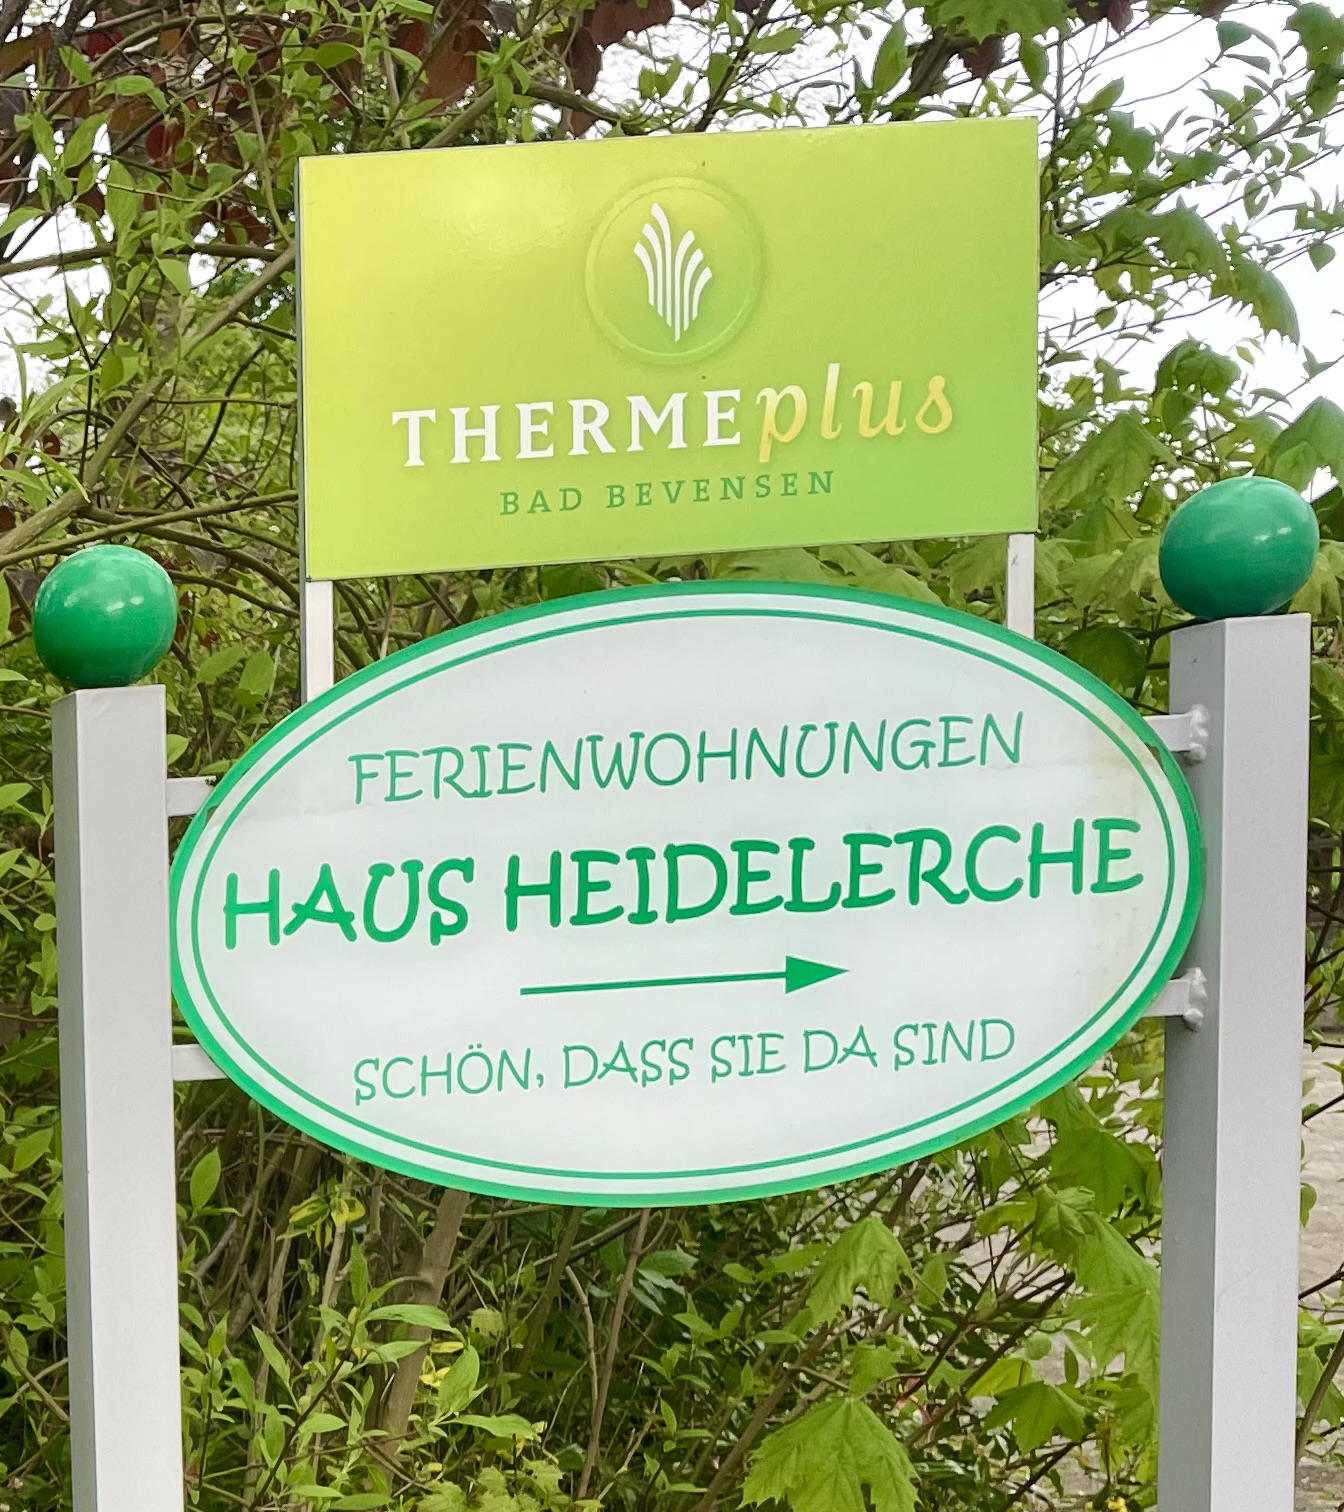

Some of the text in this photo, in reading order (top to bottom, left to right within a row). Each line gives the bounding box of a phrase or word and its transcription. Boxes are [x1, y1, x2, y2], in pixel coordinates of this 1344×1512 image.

[391, 362, 955, 467] THERMEplus
[500, 470, 835, 516] BAD BEVENSEN
[348, 711, 1024, 806] FERIENWOHNUNGEN
[222, 816, 1146, 951] HAUS HEIDELERCHE
[353, 1017, 1016, 1107] SCHÖN, DASS SIE DA SIND
